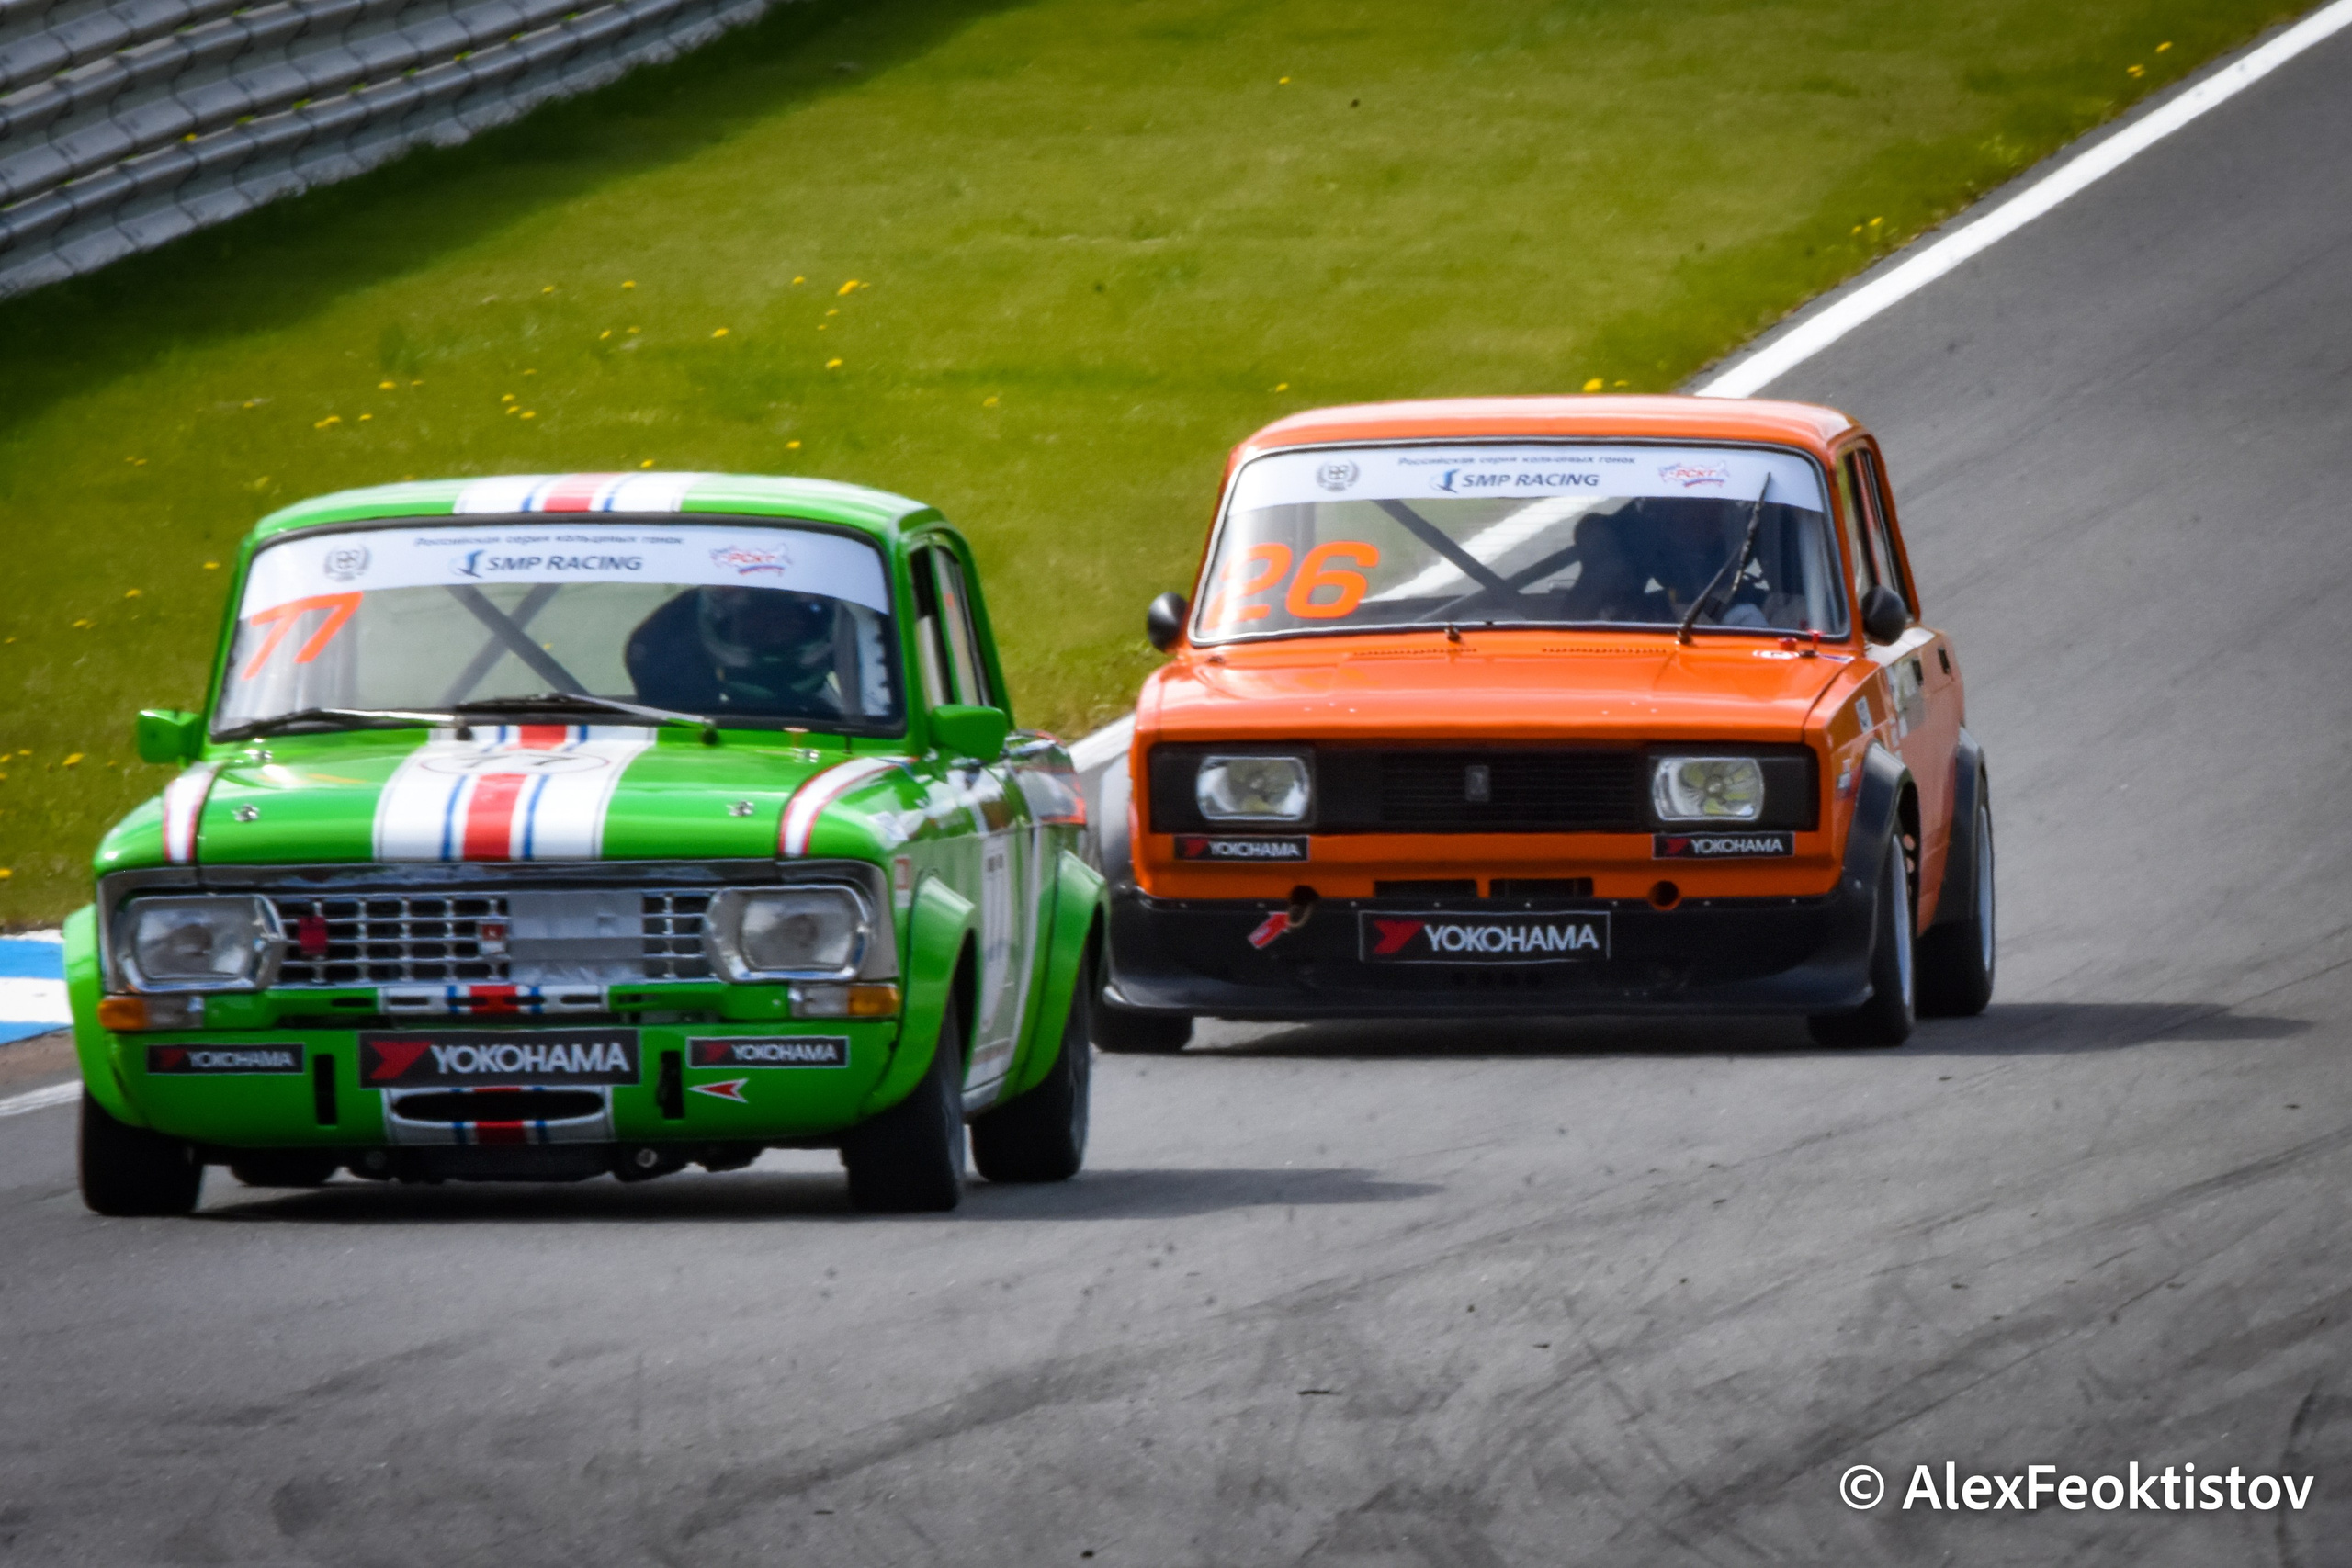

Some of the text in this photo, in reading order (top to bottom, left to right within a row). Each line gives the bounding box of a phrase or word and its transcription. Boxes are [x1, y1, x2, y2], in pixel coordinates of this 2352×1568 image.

[1462, 473, 1600, 488] SMP RACING
[485, 555, 643, 571] SMP RACING
[1201, 540, 1381, 632] 26
[241, 591, 364, 682] 77
[1208, 841, 1302, 857] YOKOHAMA
[1690, 838, 1785, 854] YOKOHAMA
[1424, 924, 1600, 953] YOKOHAMA
[187, 1050, 296, 1068] YOKOHAMA
[430, 1042, 631, 1075] YOKOHAMA
[731, 1043, 839, 1062] YOKOHAMA
